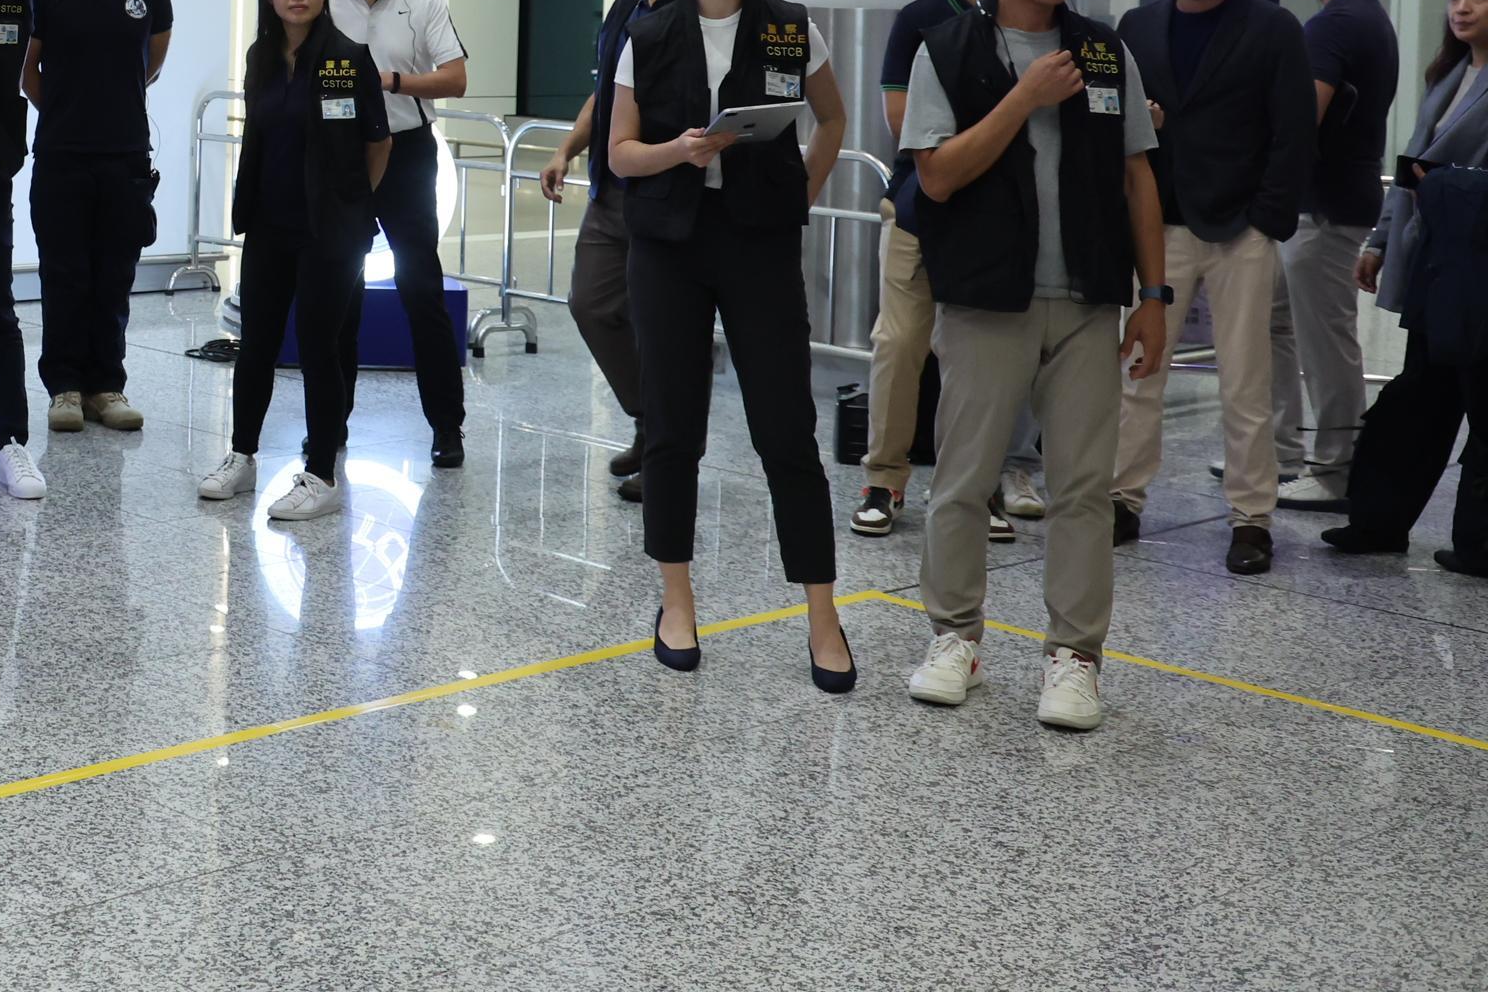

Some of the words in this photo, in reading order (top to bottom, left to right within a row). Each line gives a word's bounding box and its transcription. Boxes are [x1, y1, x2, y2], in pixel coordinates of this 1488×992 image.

[760, 33, 807, 44] POLICE
[766, 46, 803, 57] CSTCB
[318, 68, 357, 77] POLICE
[1086, 61, 1119, 74] CSTCB
[322, 79, 354, 88] CSTCB
